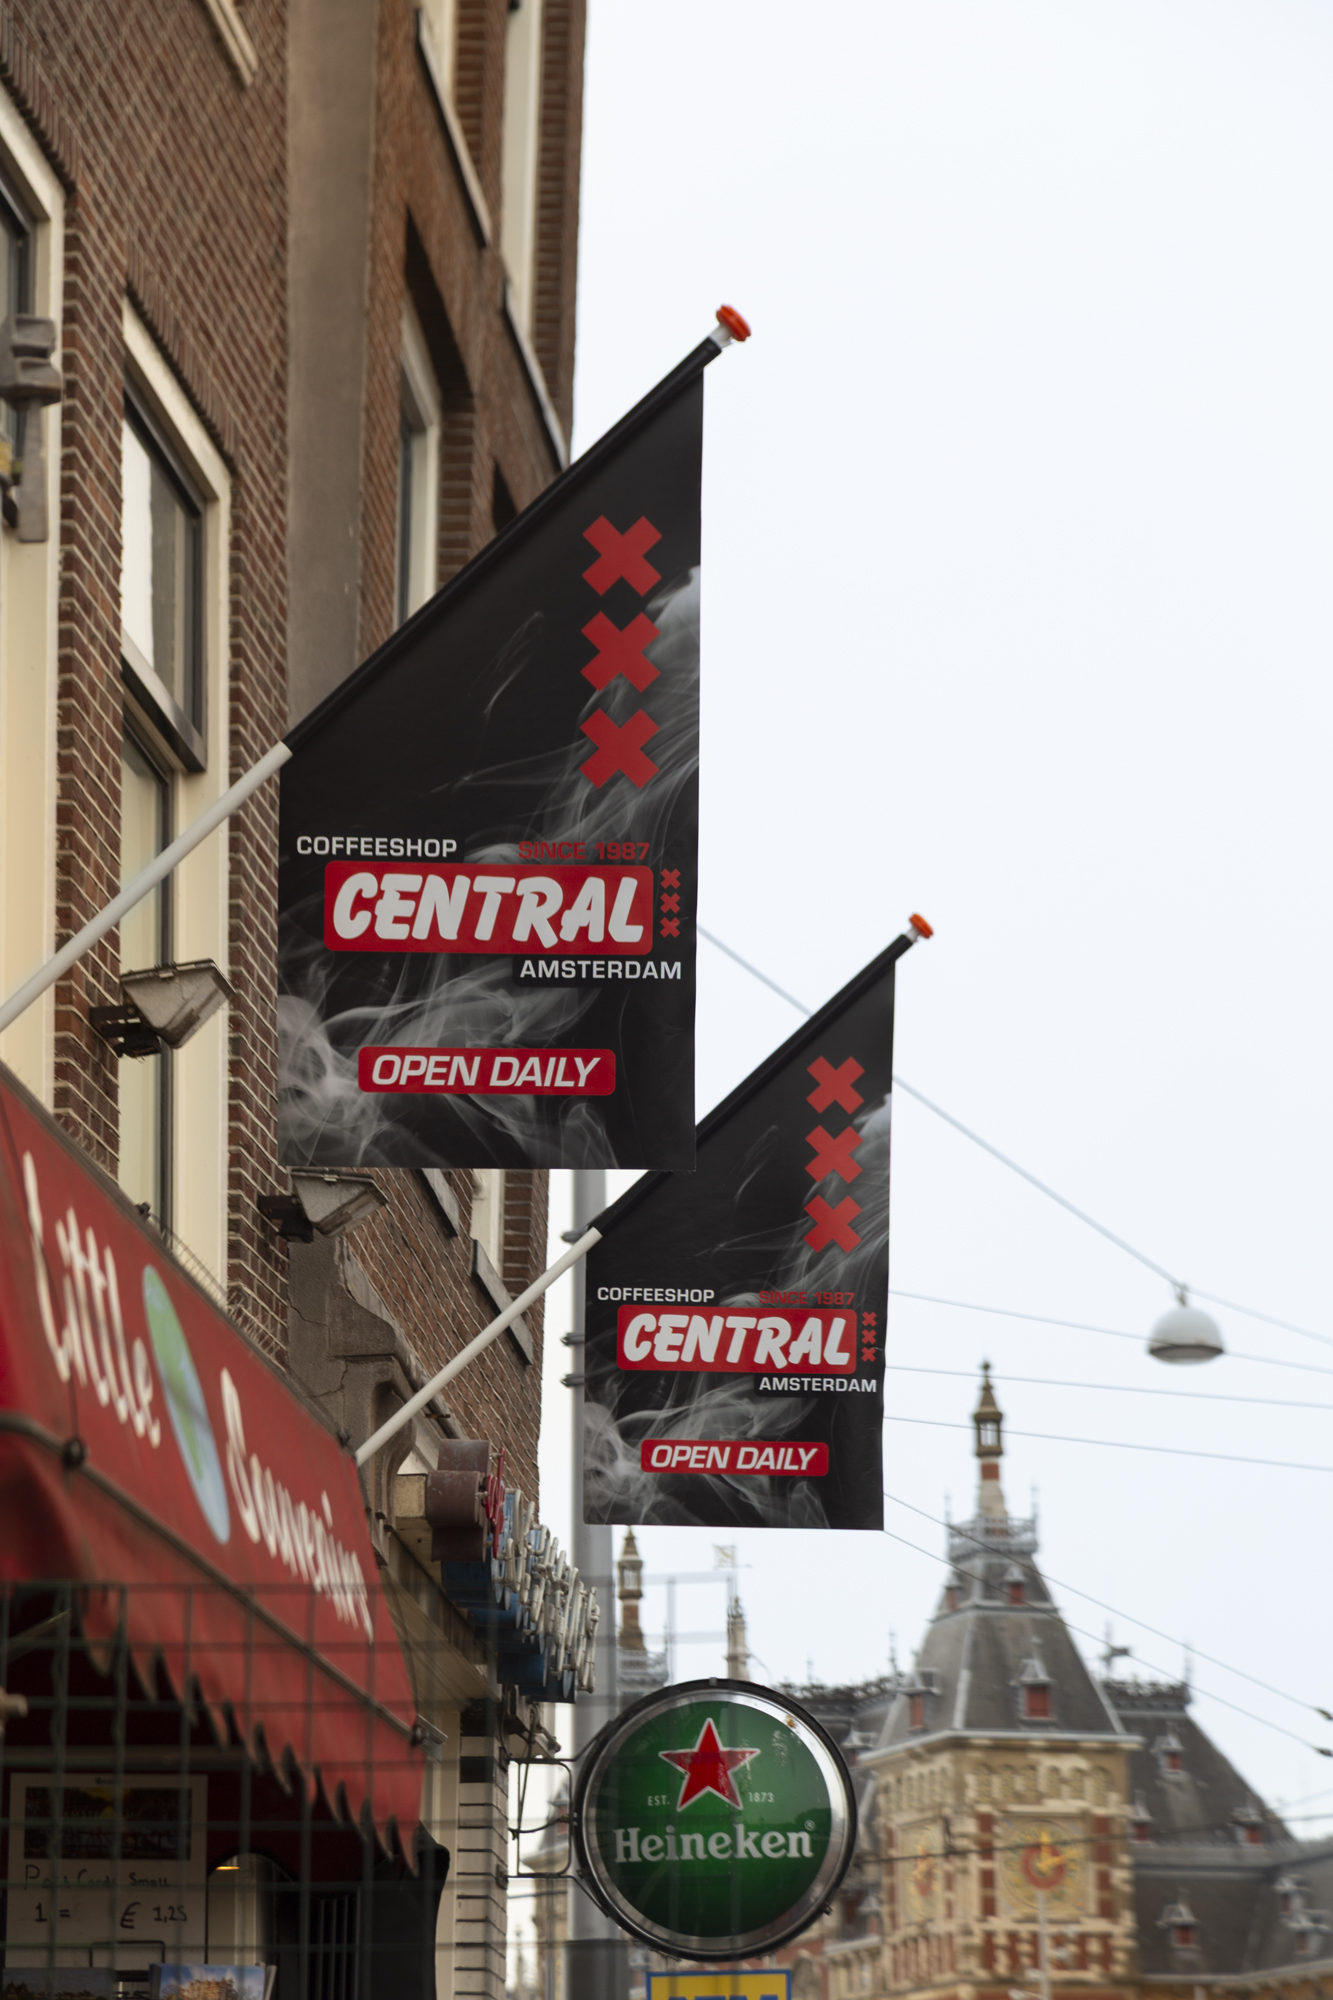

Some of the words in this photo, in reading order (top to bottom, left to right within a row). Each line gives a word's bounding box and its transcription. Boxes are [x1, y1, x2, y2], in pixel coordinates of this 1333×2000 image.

[296, 835, 457, 858] COFFEESHOP
[518, 841, 586, 860] SINCE
[594, 841, 650, 861] 1987
[332, 871, 644, 949] CENTRAL
[519, 959, 682, 980] AMSTERDAM
[371, 1054, 480, 1086] OPEN
[489, 1056, 601, 1088] DAILY
[597, 1287, 715, 1303] COFFEESHOP
[758, 1290, 808, 1305] SINCE
[813, 1291, 855, 1305] 1987
[623, 1313, 850, 1369] CENTRAL
[759, 1376, 877, 1393] AMSTERDAM
[22, 1150, 161, 1449] Little
[220, 1366, 374, 1645] Souvenirs
[650, 1444, 731, 1469] OPEN
[736, 1447, 818, 1471] DAILY
[647, 1795, 670, 1806] EST.
[749, 1792, 774, 1803] 1873
[129, 1871, 171, 1888] Small
[35, 1902, 48, 1922] 1
[120, 1901, 141, 1929] €
[152, 1905, 188, 1923] 1,25
